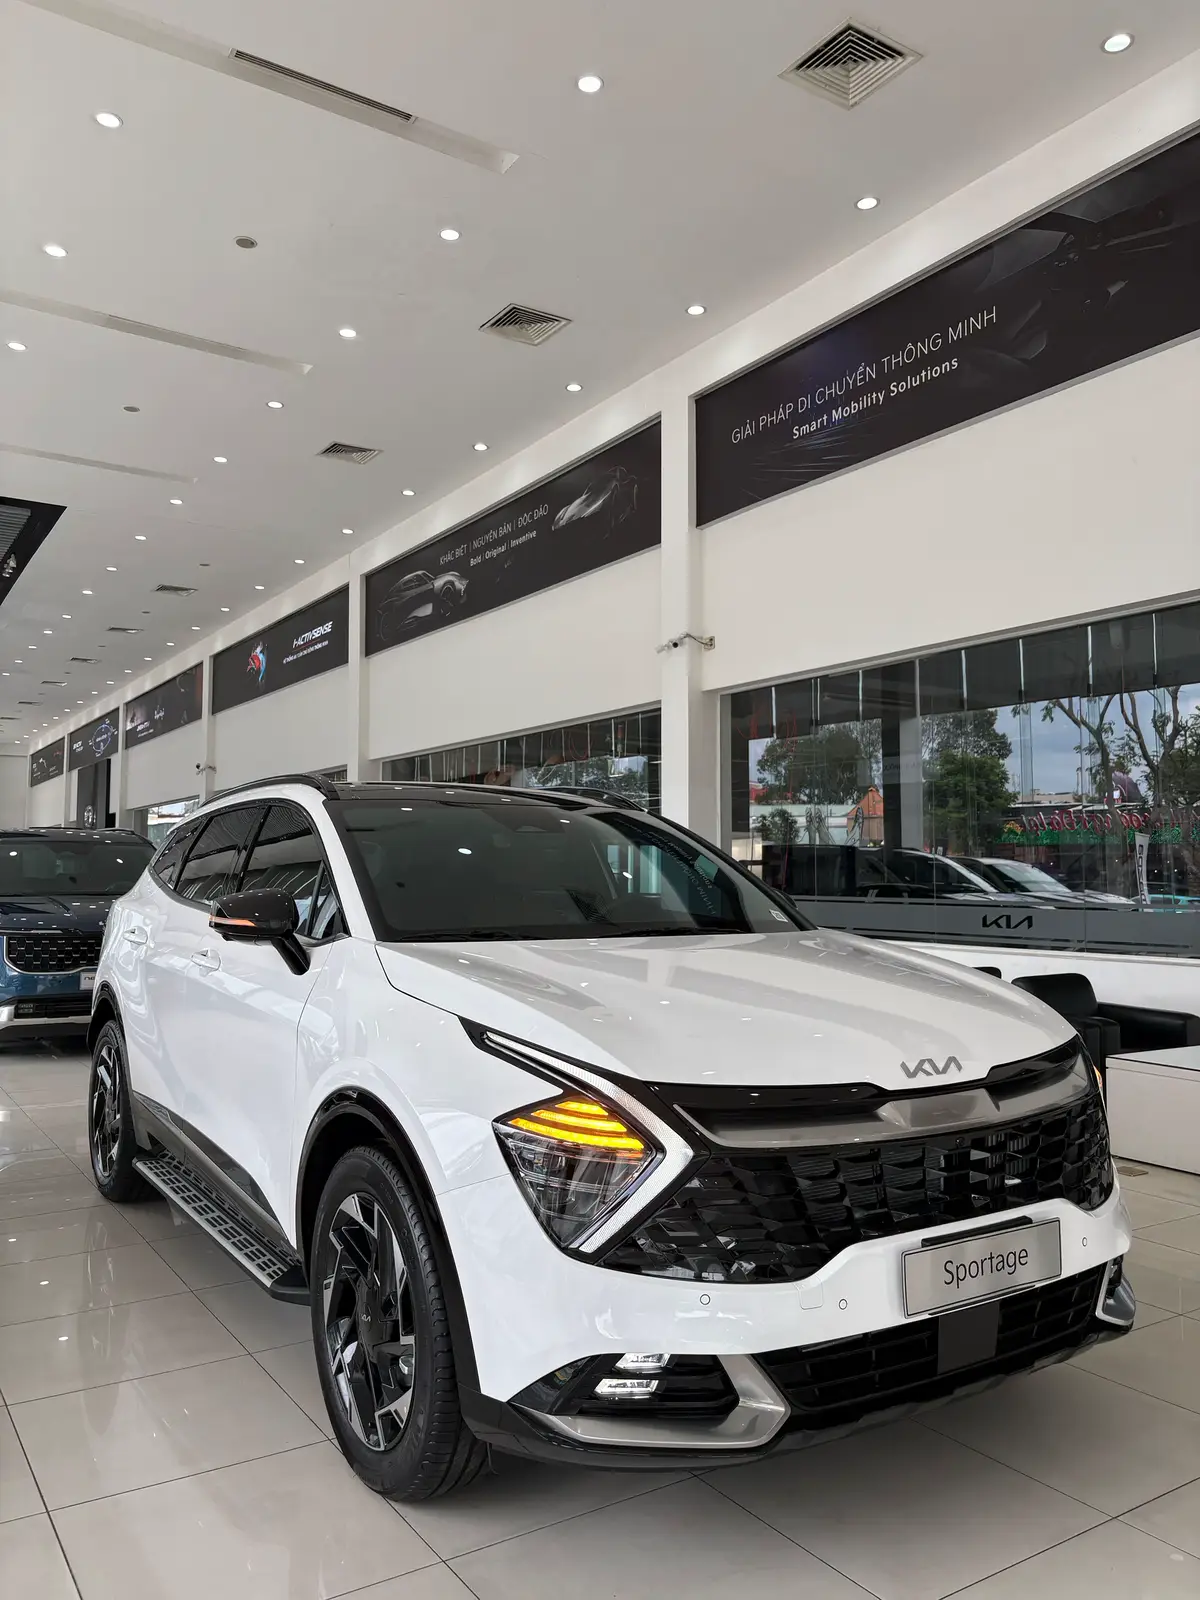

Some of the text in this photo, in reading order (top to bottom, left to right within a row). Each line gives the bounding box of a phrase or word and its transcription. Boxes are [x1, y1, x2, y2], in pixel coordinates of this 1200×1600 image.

[731, 305, 997, 444] GIẢI PHÁP DI CHUYỂN THÔNG MINH
[792, 357, 959, 439] Smart Mobility Solutions
[485, 542, 507, 560] Original
[510, 530, 537, 548] Inventive
[981, 913, 1034, 930] KIA
[899, 1055, 963, 1079] KIA
[943, 1247, 1030, 1290] Sportage
